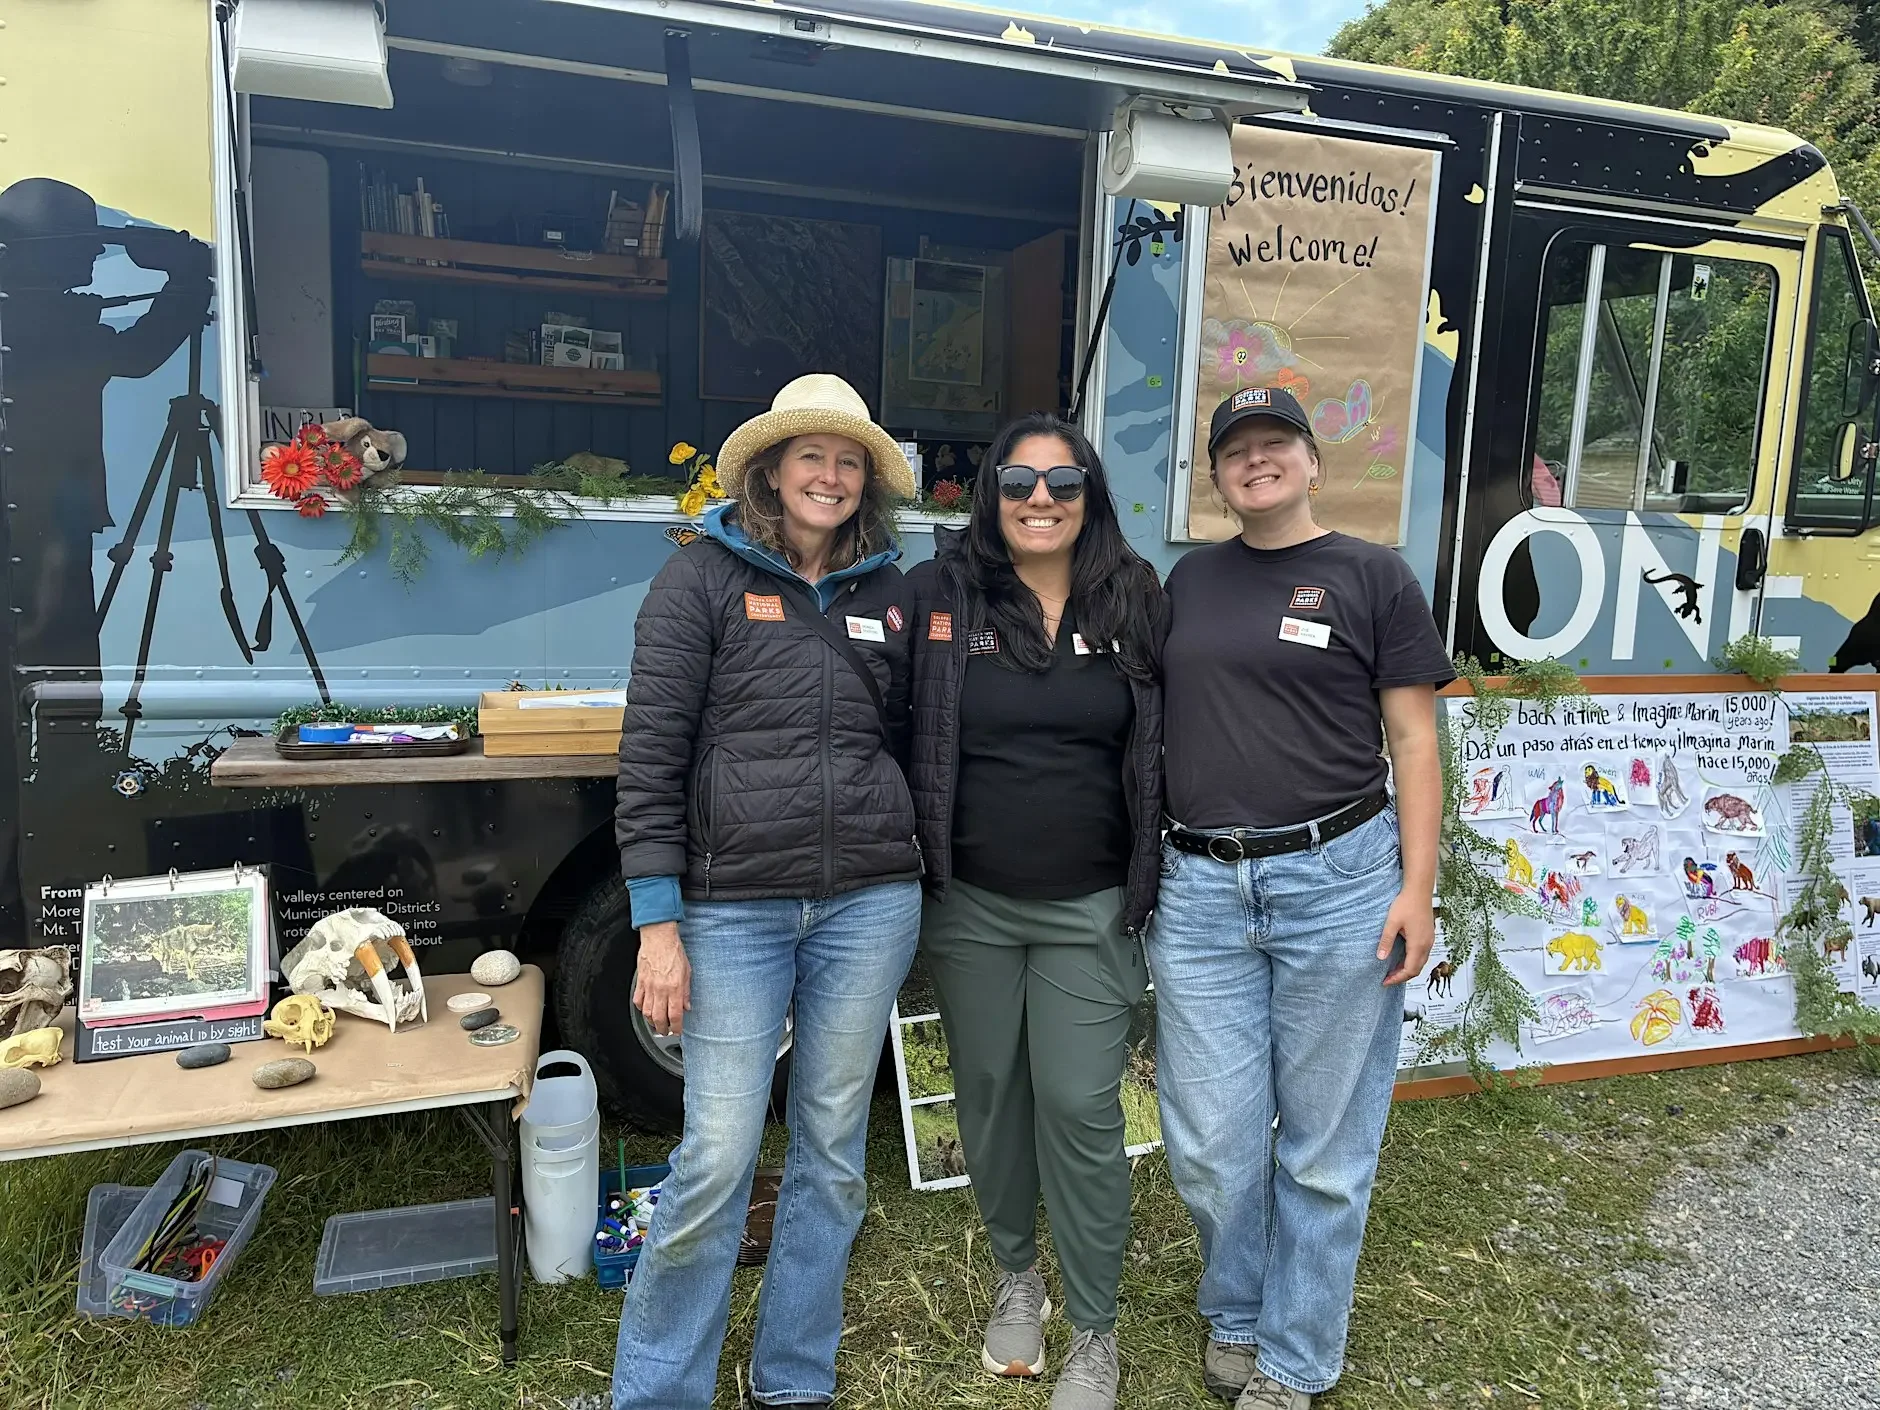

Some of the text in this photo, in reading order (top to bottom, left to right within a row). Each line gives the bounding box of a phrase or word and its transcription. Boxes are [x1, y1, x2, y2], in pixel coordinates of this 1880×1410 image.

[750, 606, 781, 614] PARKS
[931, 625, 951, 633] PARK
[1617, 703, 1625, 721] &
[1632, 702, 1682, 729] Imagine
[1684, 702, 1721, 723] Marin
[1725, 695, 1767, 715] 15,000
[1727, 716, 1752, 730] years
[1496, 742, 1517, 758] un
[1522, 739, 1554, 758] paso
[1560, 732, 1594, 752] atrás
[1597, 738, 1615, 750] en
[1617, 734, 1629, 750] el
[1631, 733, 1667, 753] tiempo
[1737, 735, 1776, 751] Marin
[1697, 753, 1770, 773] hace 15,000
[41, 886, 82, 900] From
[282, 889, 325, 904] valleys
[329, 885, 384, 900] centered
[387, 888, 404, 898] on
[42, 904, 81, 918] More
[386, 900, 441, 915] District's
[43, 922, 68, 936] Mt.
[413, 919, 437, 930] into
[408, 934, 442, 946] about
[96, 1034, 122, 1052] test
[155, 1028, 194, 1045] animal
[210, 1025, 225, 1040] by
[228, 1019, 257, 1039] sight
